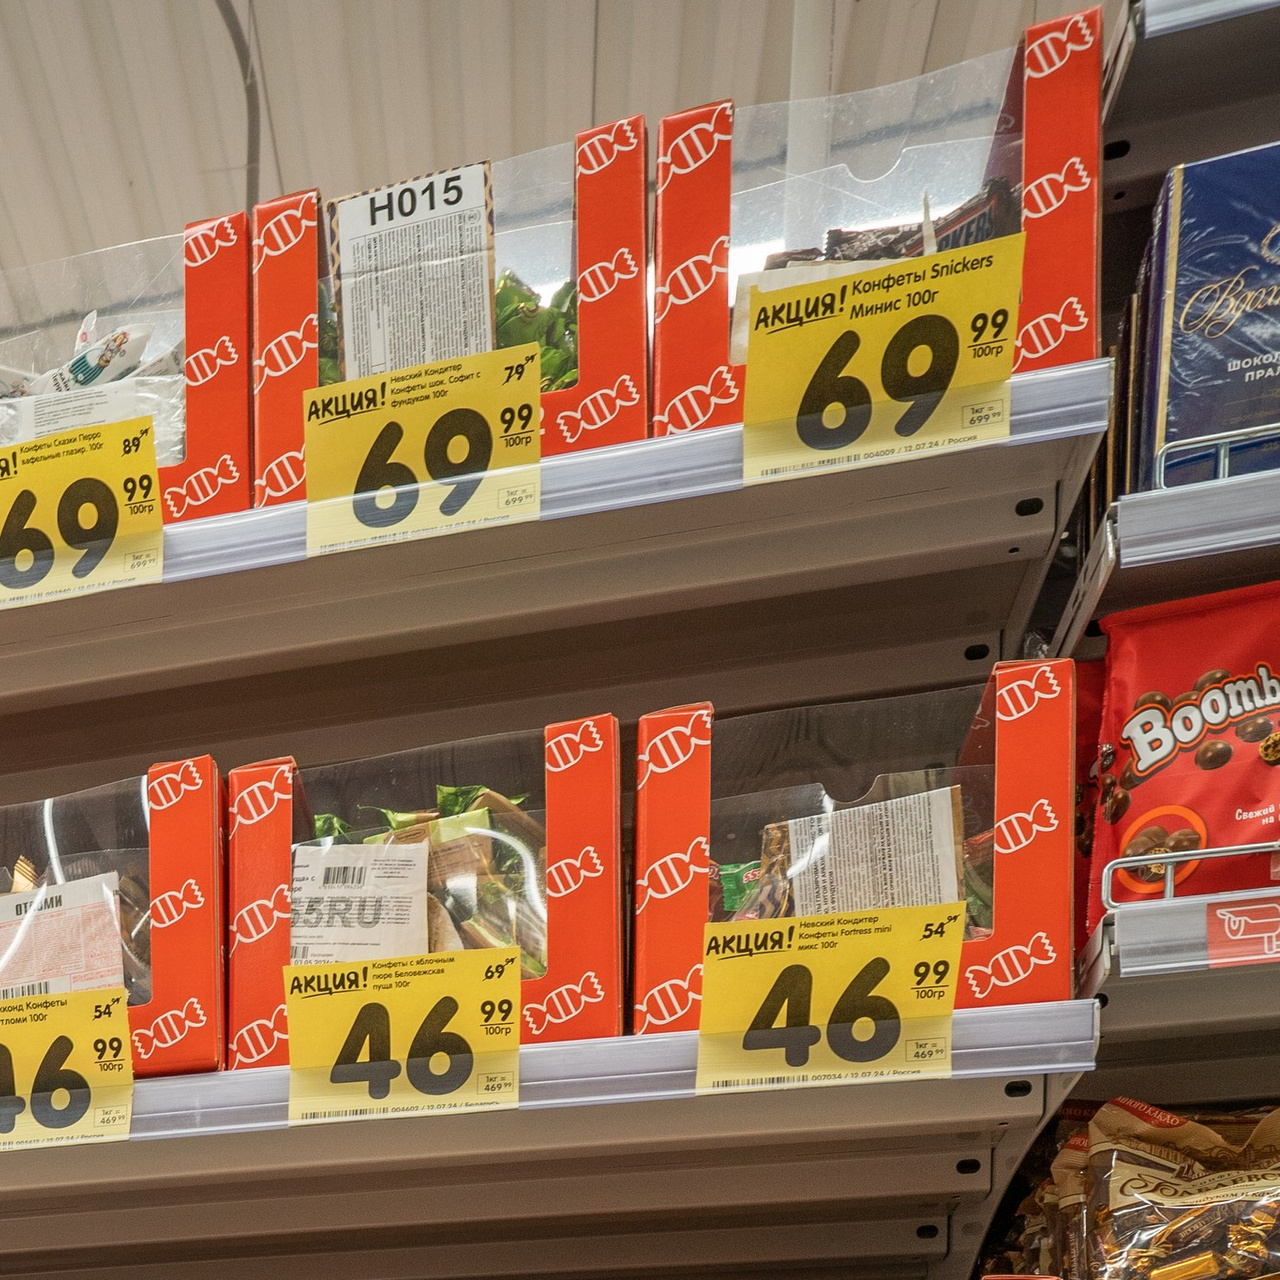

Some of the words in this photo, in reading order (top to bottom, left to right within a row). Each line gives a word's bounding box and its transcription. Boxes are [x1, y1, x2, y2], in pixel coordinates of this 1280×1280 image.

[370, 175, 463, 225] H015
[852, 271, 926, 296] Конфеты
[931, 253, 993, 279] Snickers
[755, 285, 847, 330] АКЦИЯ!
[850, 300, 901, 320] Минис
[907, 289, 939, 308] 100г
[796, 314, 959, 450] 69
[971, 309, 1009, 343] 99
[799, 930, 838, 940] Конфеты
[841, 927, 872, 937] Fortress
[874, 925, 892, 933] mini
[743, 957, 901, 1067] 46
[913, 960, 950, 986] 99
[915, 990, 944, 1000] 100гр
